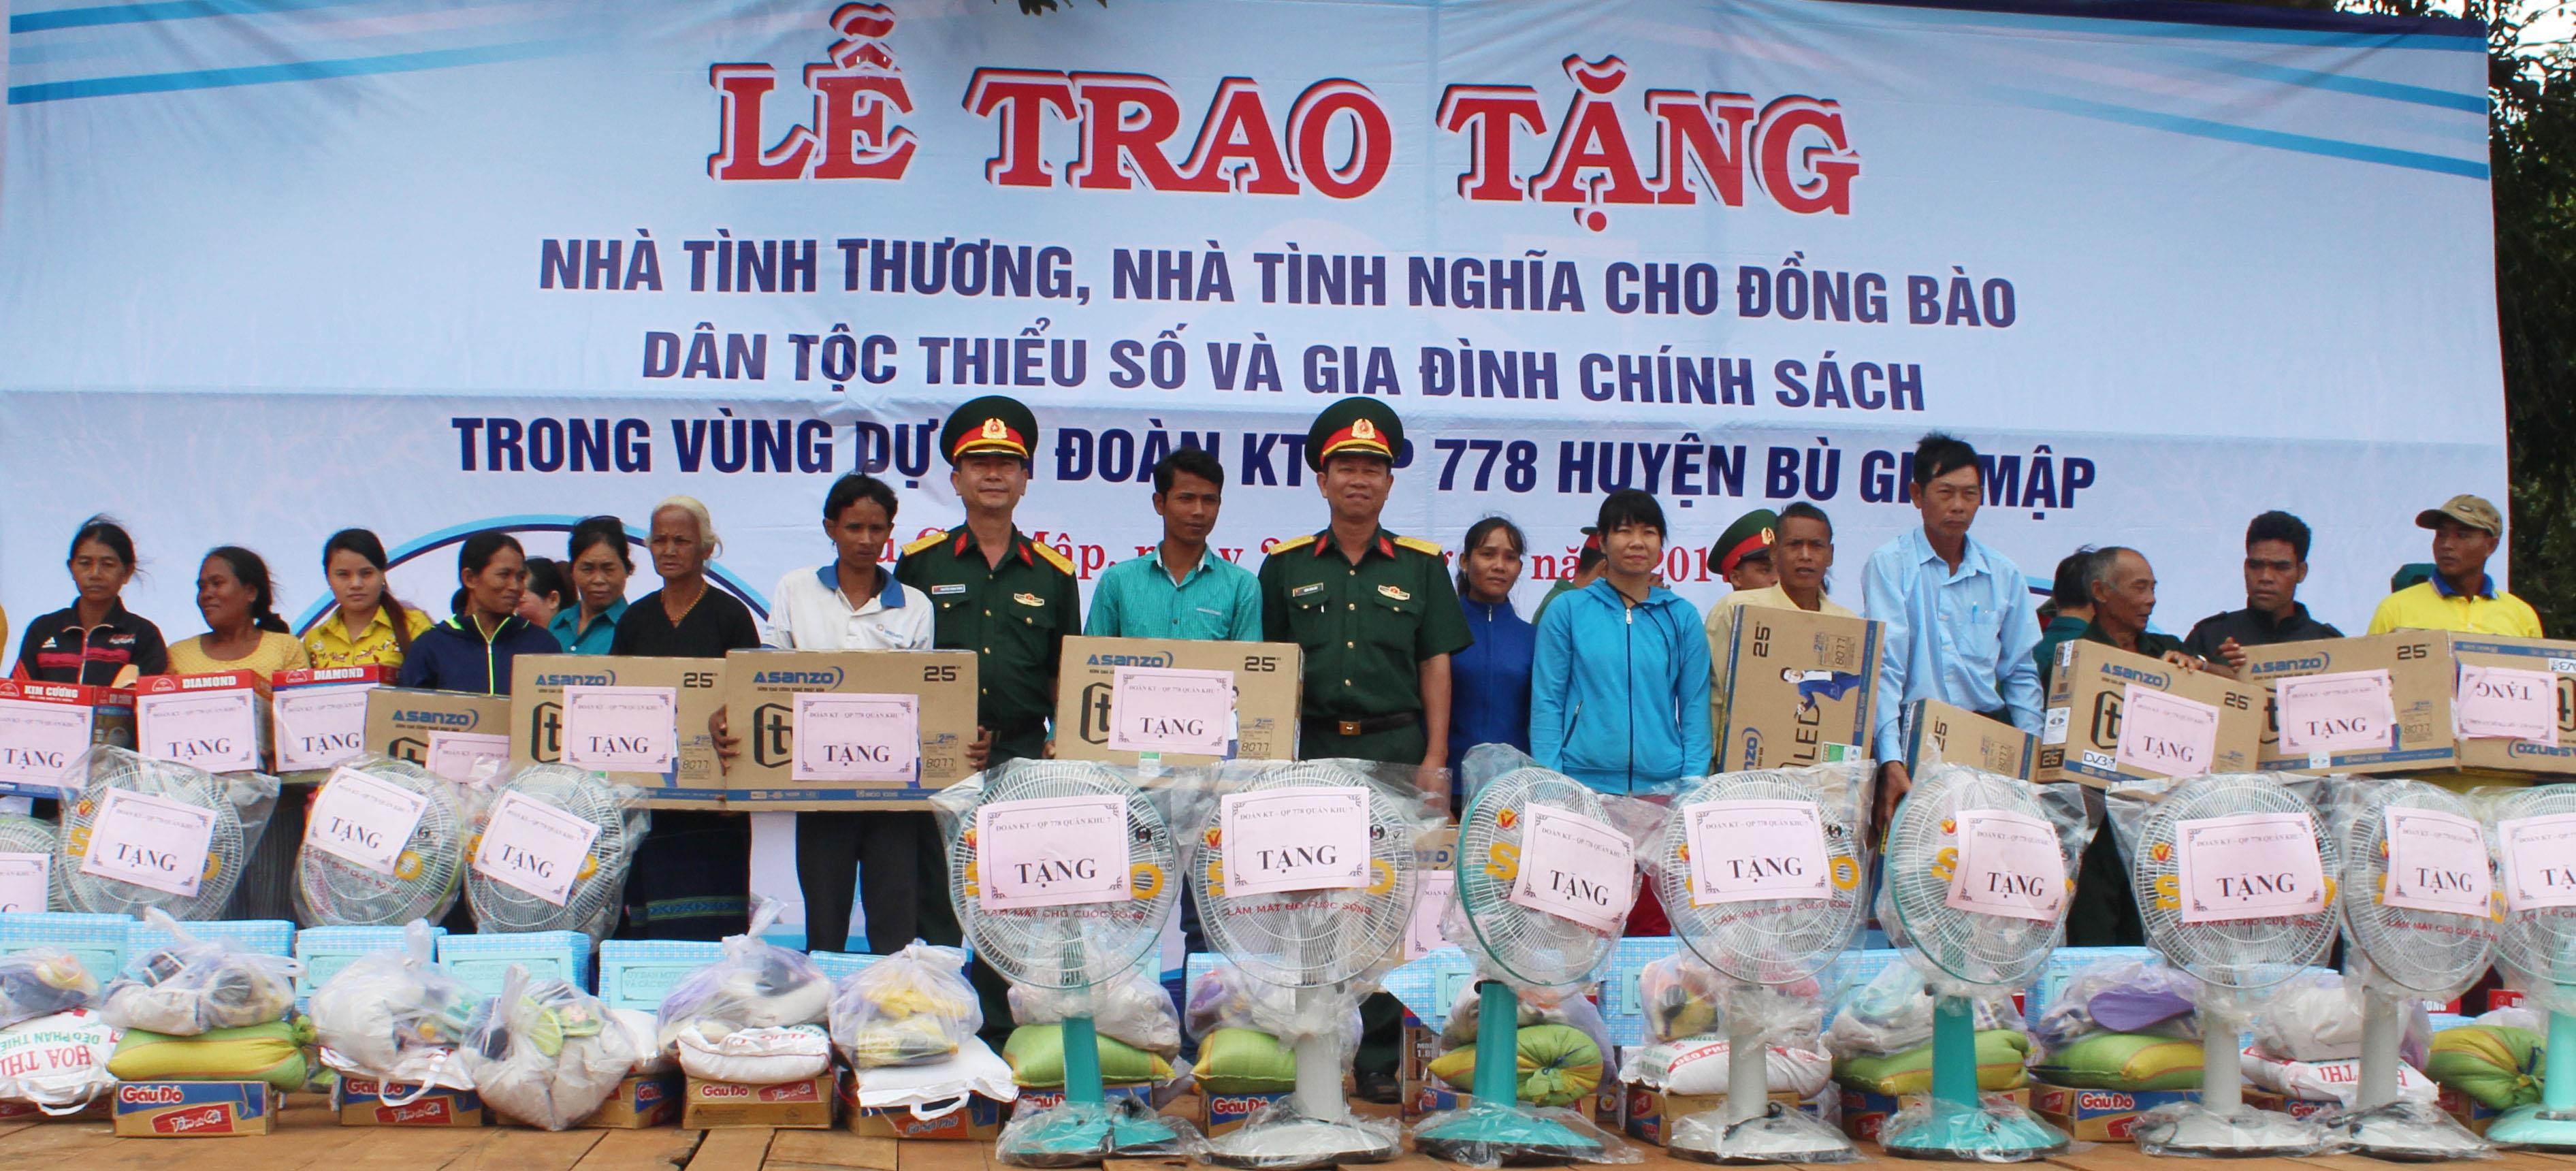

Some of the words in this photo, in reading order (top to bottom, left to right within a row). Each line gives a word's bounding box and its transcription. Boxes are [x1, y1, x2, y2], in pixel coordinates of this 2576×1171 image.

[708, 1, 918, 180] LỄ
[963, 67, 1392, 199] TRAO
[1436, 53, 1860, 232] TẶNG
[541, 228, 662, 291] NHÀ
[683, 229, 817, 292] TÌNH
[837, 238, 1090, 306] THƯƠNG,
[1113, 240, 1234, 302] NHÀ
[1253, 242, 1386, 305] TÌNH
[1408, 250, 1585, 312] NGHĨA
[1605, 261, 1718, 315] CHO
[1737, 249, 1888, 324] ĐỒNG
[1908, 266, 2016, 328] BÀO
[643, 322, 767, 381] DÂN
[788, 325, 897, 391] TỘC
[918, 317, 1087, 388] THIỂU
[1109, 323, 1188, 389] SỐ
[1207, 332, 1283, 391] VÀ
[1303, 346, 1401, 396] GIA
[1419, 338, 1559, 400] ĐÌNH
[1580, 344, 1755, 406] CHÍNH
[1775, 351, 1925, 411] SÁCH
[453, 418, 651, 472] TRONG
[671, 408, 833, 472] VÙNG
[855, 418, 939, 489] DỰ
[1435, 438, 1537, 493] 778
[1558, 433, 1746, 508] HUYỆN
[1765, 437, 1840, 502] BÙ
[1860, 450, 1914, 503] GI
[1978, 445, 2095, 520] MẬP
[1531, 545, 1581, 579] nă
[1655, 546, 1711, 582] 201
[1086, 654, 1164, 668] Asanzo
[2251, 656, 2322, 674] Asanzo
[182, 675, 236, 688] DIAMOND
[314, 668, 364, 680] DIAMOND
[535, 674, 608, 686] Asanzo
[753, 671, 835, 684] Asanzo
[2100, 662, 2163, 688] Asanzo
[25, 685, 44, 694] KIM
[392, 709, 470, 726] Asanzo
[1140, 716, 1203, 738] TẶNG
[2306, 717, 2366, 739] TẶNG
[1793, 703, 1821, 761] LED
[589, 735, 649, 756] TẶNG
[823, 743, 890, 766] TẶNG
[1241, 742, 1270, 752] 8077
[2144, 735, 2194, 763] TẶNG
[926, 758, 955, 769] 8077
[1037, 820, 1048, 829] QP
[1050, 819, 1062, 827] 778
[1281, 809, 1291, 817] QP
[1257, 844, 1337, 873] TẶNG
[1726, 854, 1803, 883] TẶNG
[1014, 857, 1097, 888] TẶNG
[2416, 867, 2473, 893] TẶNG
[2540, 865, 2576, 890] TẶ
[1550, 869, 1609, 907] TẶNG
[1987, 870, 2045, 899] TẶNG
[2217, 871, 2296, 901] TẶNG
[34, 1031, 70, 1043] PHAN
[45, 1046, 91, 1068] HOA
[1704, 1042, 1729, 1056] PHA
